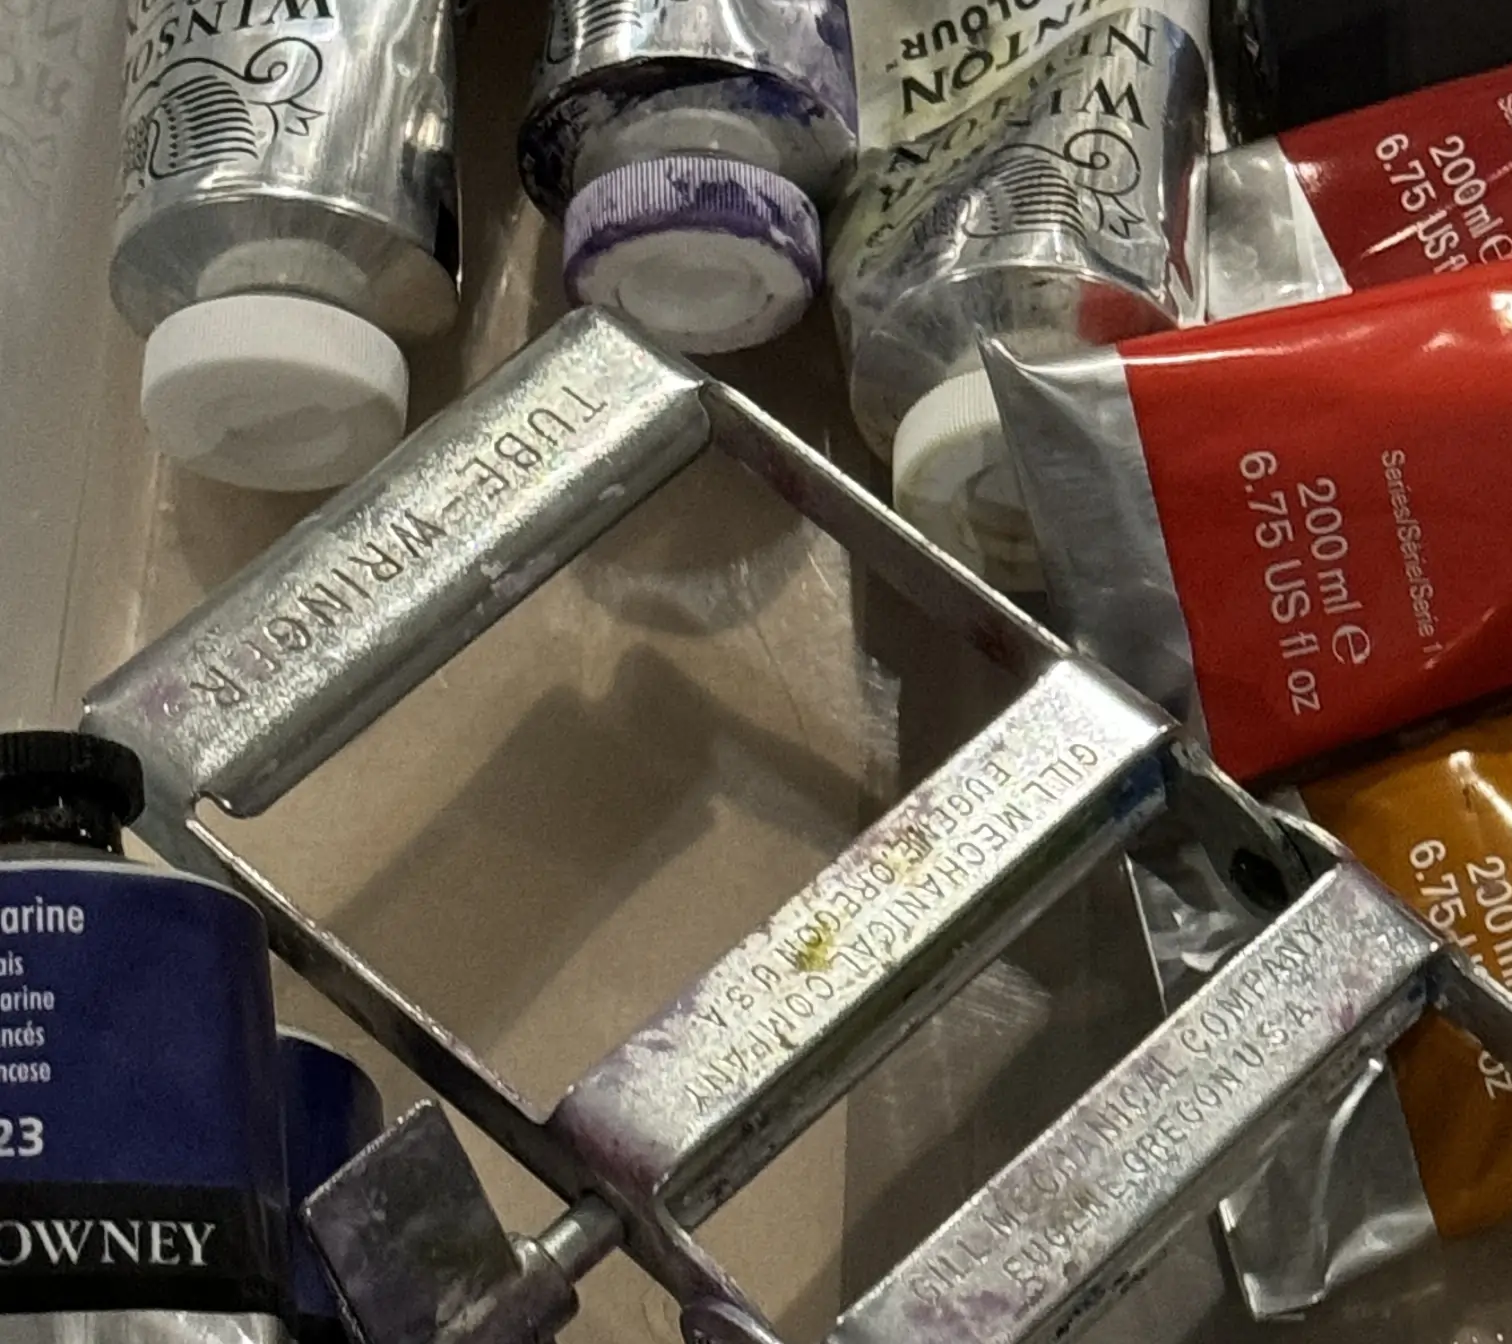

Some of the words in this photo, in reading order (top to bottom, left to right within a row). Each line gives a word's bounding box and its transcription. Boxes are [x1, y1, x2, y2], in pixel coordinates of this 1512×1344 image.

[1374, 132, 1437, 212] 6.75
[1427, 135, 1488, 206] 200
[1461, 203, 1505, 239] ml
[1238, 449, 1295, 550] 6.75
[1297, 476, 1349, 562] 200
[1263, 558, 1311, 624] US
[1316, 567, 1363, 615] ml
[1278, 630, 1322, 660] fl
[1285, 669, 1321, 716] oz
[1021, 741, 1100, 803] GILL
[827, 802, 1034, 966] MECHANICAL
[1408, 839, 1467, 931] 6.75
[684, 972, 836, 1111] COMPANY
[908, 1239, 992, 1307] GILL
[1179, 922, 1336, 1060] COMPANY
